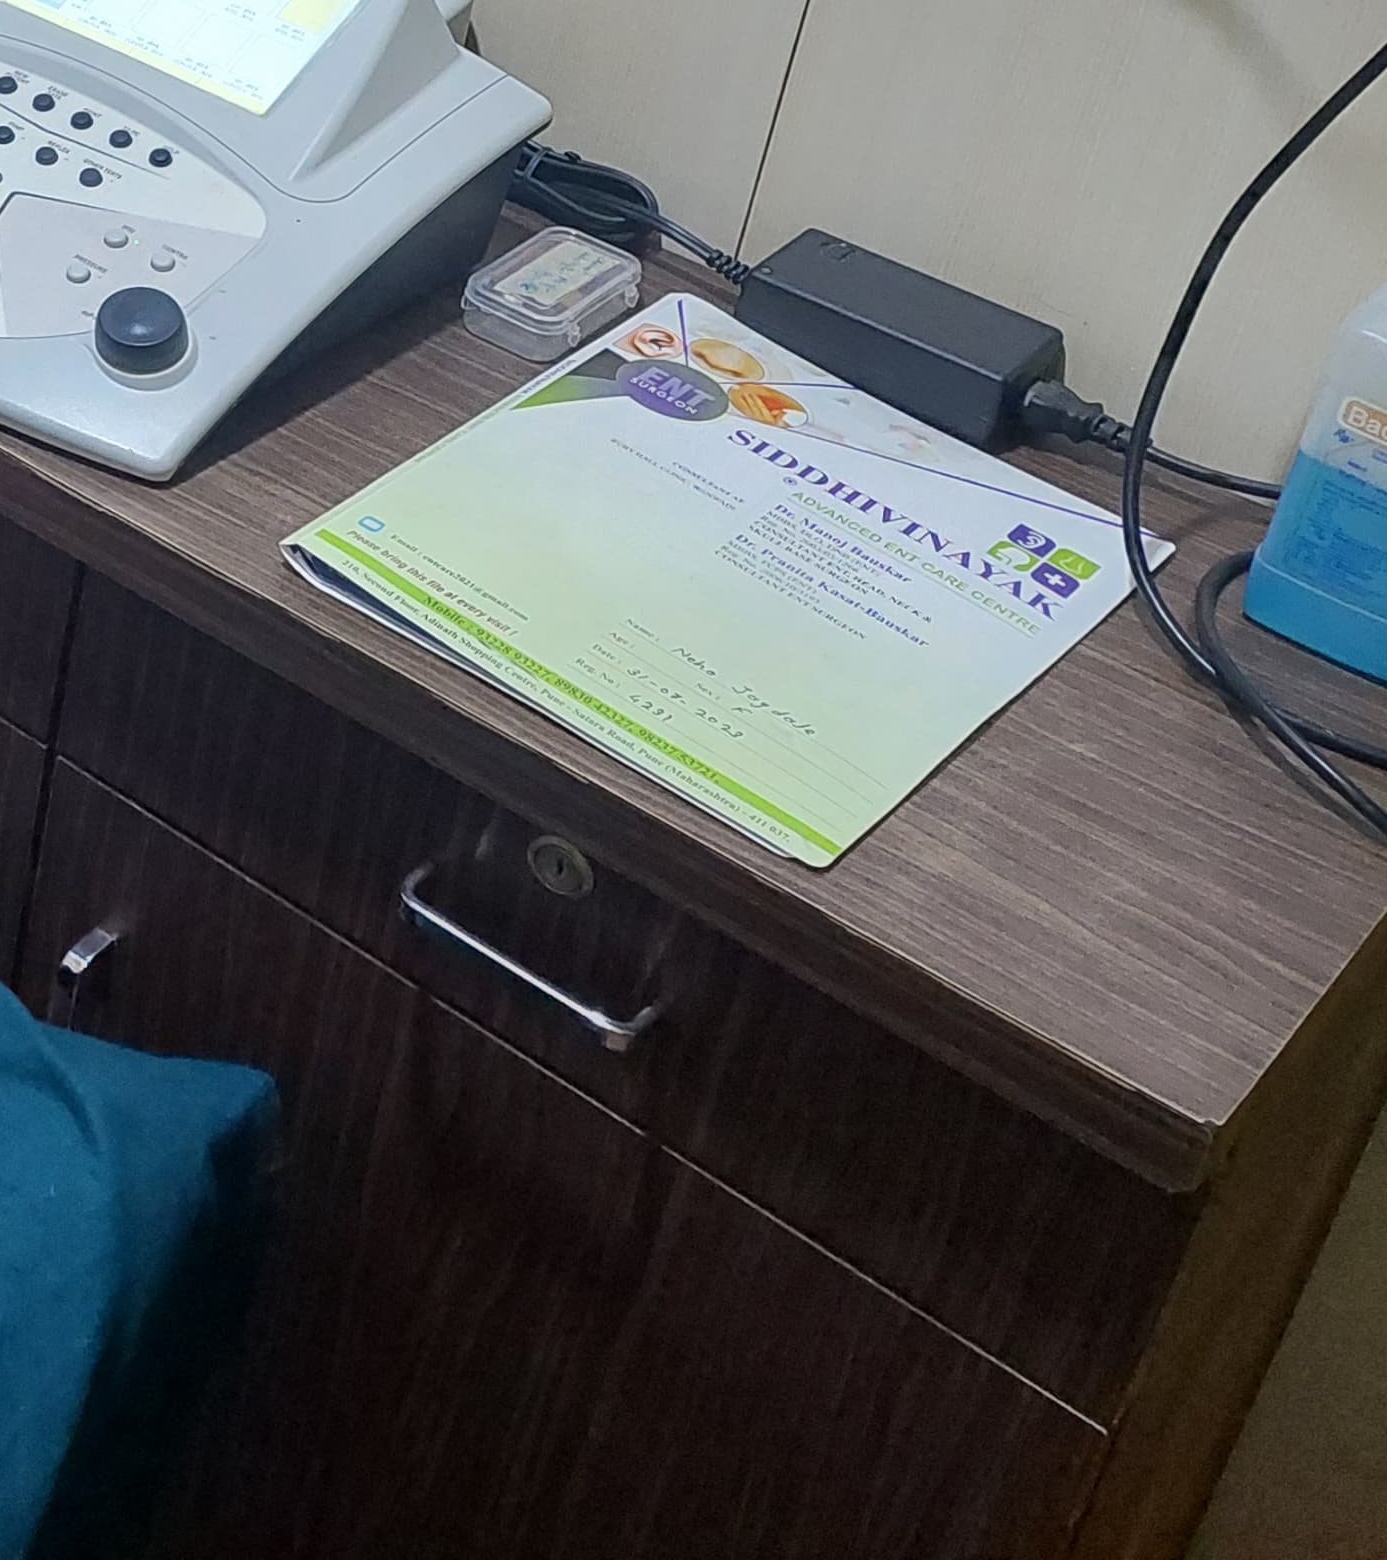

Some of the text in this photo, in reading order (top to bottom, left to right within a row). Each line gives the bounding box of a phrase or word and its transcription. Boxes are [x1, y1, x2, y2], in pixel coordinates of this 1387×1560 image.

[629, 377, 699, 416] SURGEON
[636, 366, 717, 408] ENT
[390, 534, 419, 553] Email
[727, 428, 1064, 622] SIDDHIVINAYAK
[775, 504, 914, 584] Dr. Manoj Bauskar
[791, 491, 1043, 635] ADVANCED ENT CARE CENTRE
[346, 530, 381, 551] Please
[380, 550, 408, 569] bring
[406, 567, 428, 582] this
[426, 580, 445, 593] file
[456, 599, 487, 618] every
[486, 616, 511, 632] visit
[735, 534, 931, 648] Dr. Pranita Kasat-Bauskar
[592, 644, 616, 660] Date
[610, 632, 629, 645] Age
[626, 618, 655, 638] Name
[361, 572, 395, 597] Second
[421, 614, 458, 640] Adinath
[458, 637, 503, 669] Shopping
[540, 688, 566, 707] Pune
[572, 708, 605, 731] Satara
[637, 748, 665, 766] Pune
[665, 765, 740, 812] (Maharashtra)
[748, 815, 768, 828] 411
[421, 596, 469, 627] Mobile
[472, 628, 514, 654] 93228
[554, 678, 593, 704] 89830
[639, 729, 677, 755] 98237
